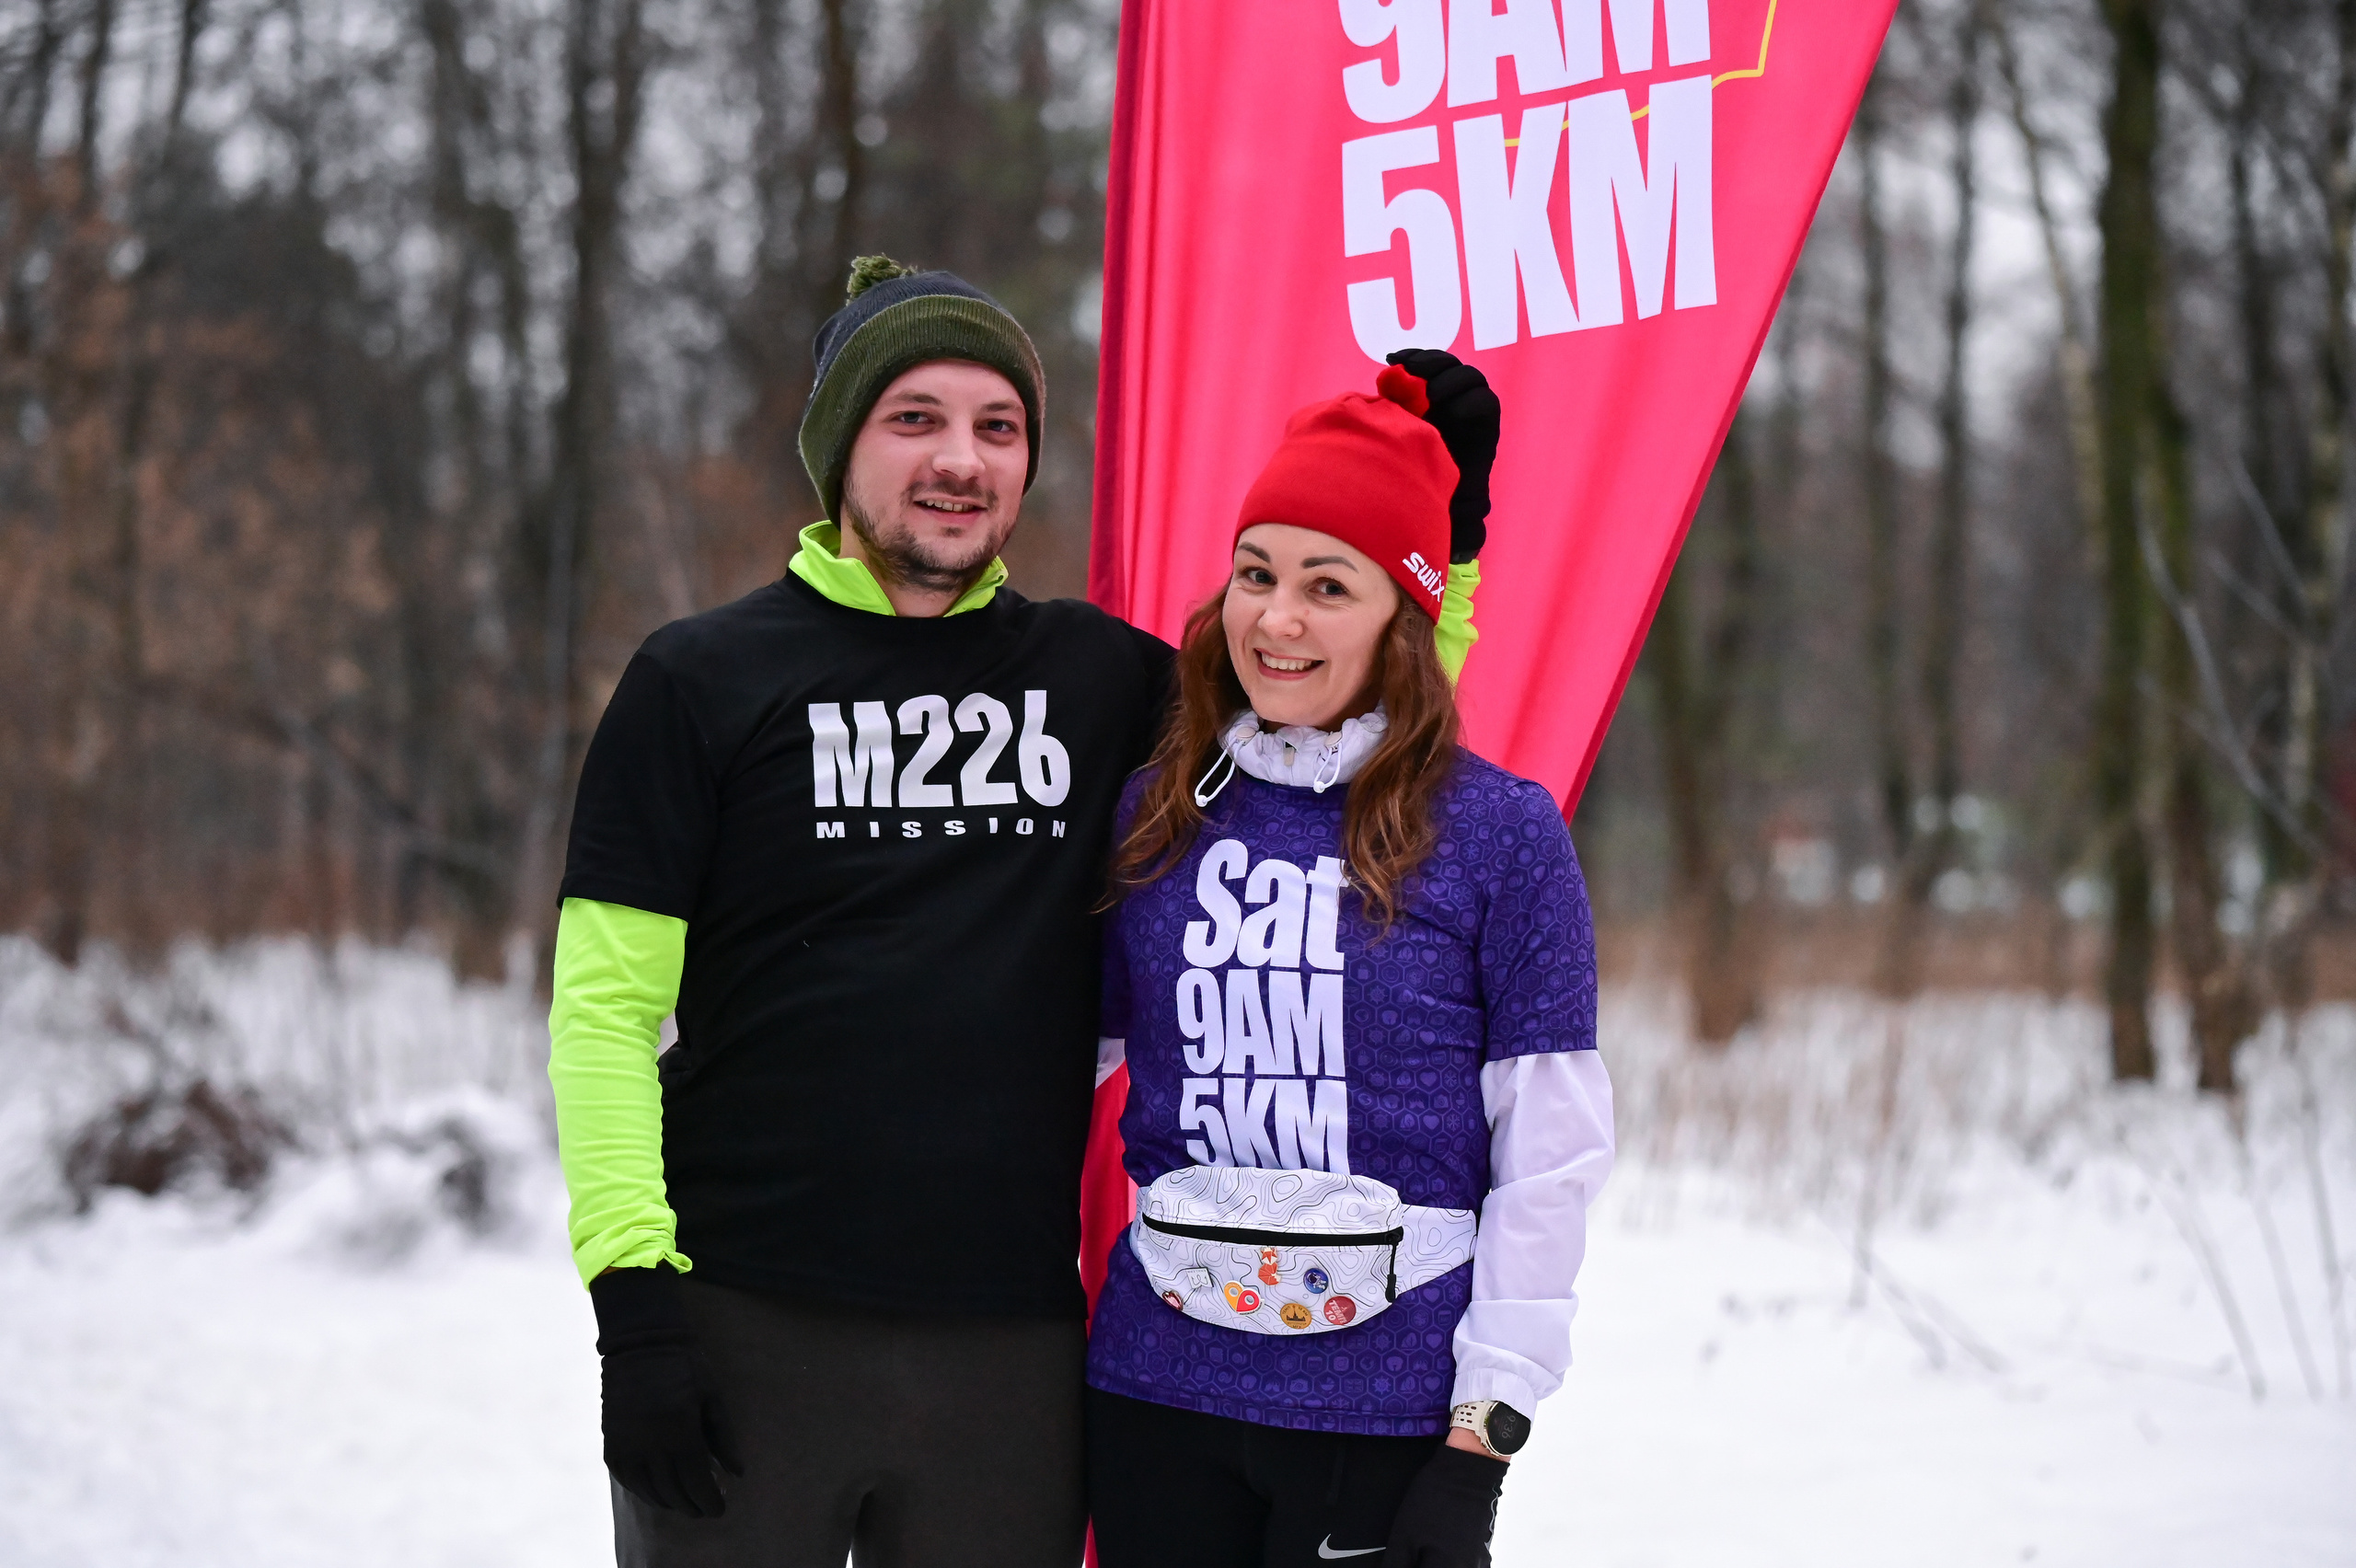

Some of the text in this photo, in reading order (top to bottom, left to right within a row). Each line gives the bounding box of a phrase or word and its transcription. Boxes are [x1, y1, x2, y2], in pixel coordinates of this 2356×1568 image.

[1338, 0, 1711, 123] 9A
[1342, 75, 1717, 366] 5KM
[808, 689, 1071, 808] M226
[815, 817, 1066, 838] MISSION
[1183, 838, 1351, 971] Sat
[1176, 968, 1345, 1078] 9AM
[1179, 1078, 1350, 1176] 5KM
